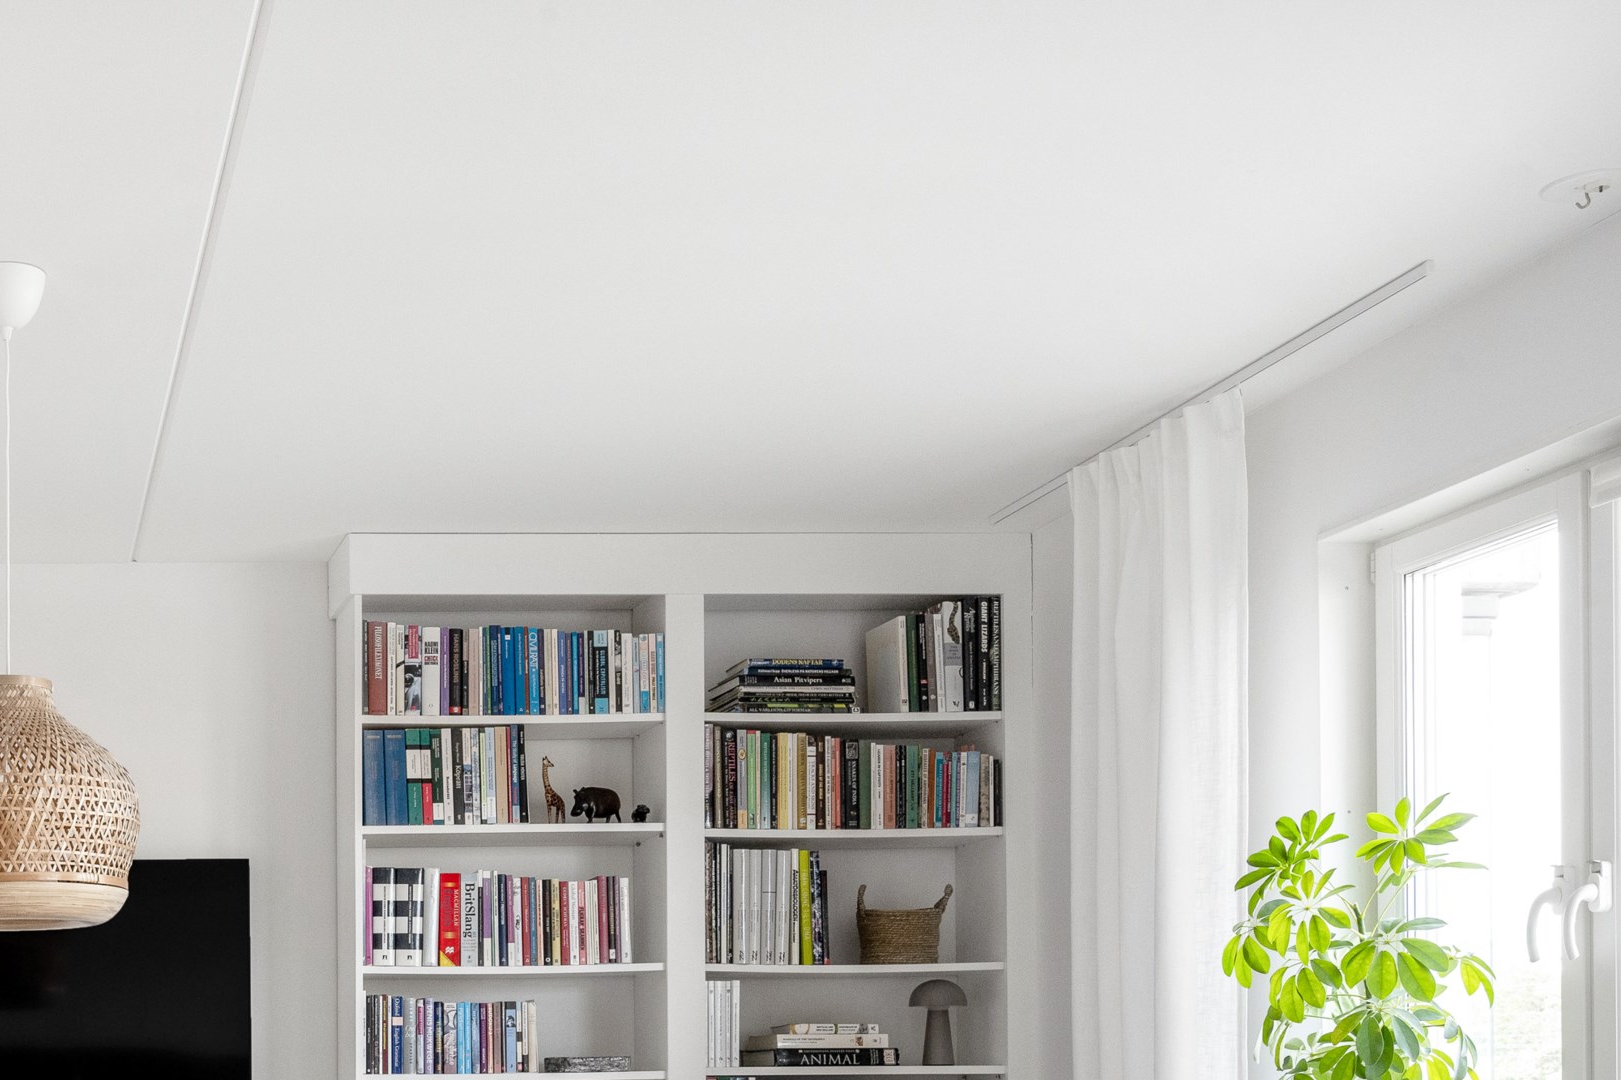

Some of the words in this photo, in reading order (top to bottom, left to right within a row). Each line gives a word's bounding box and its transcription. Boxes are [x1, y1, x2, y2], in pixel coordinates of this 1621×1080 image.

[728, 742, 736, 782] REPTILES
[463, 883, 476, 938] BritSlang
[800, 1054, 860, 1065] ANIMAL
